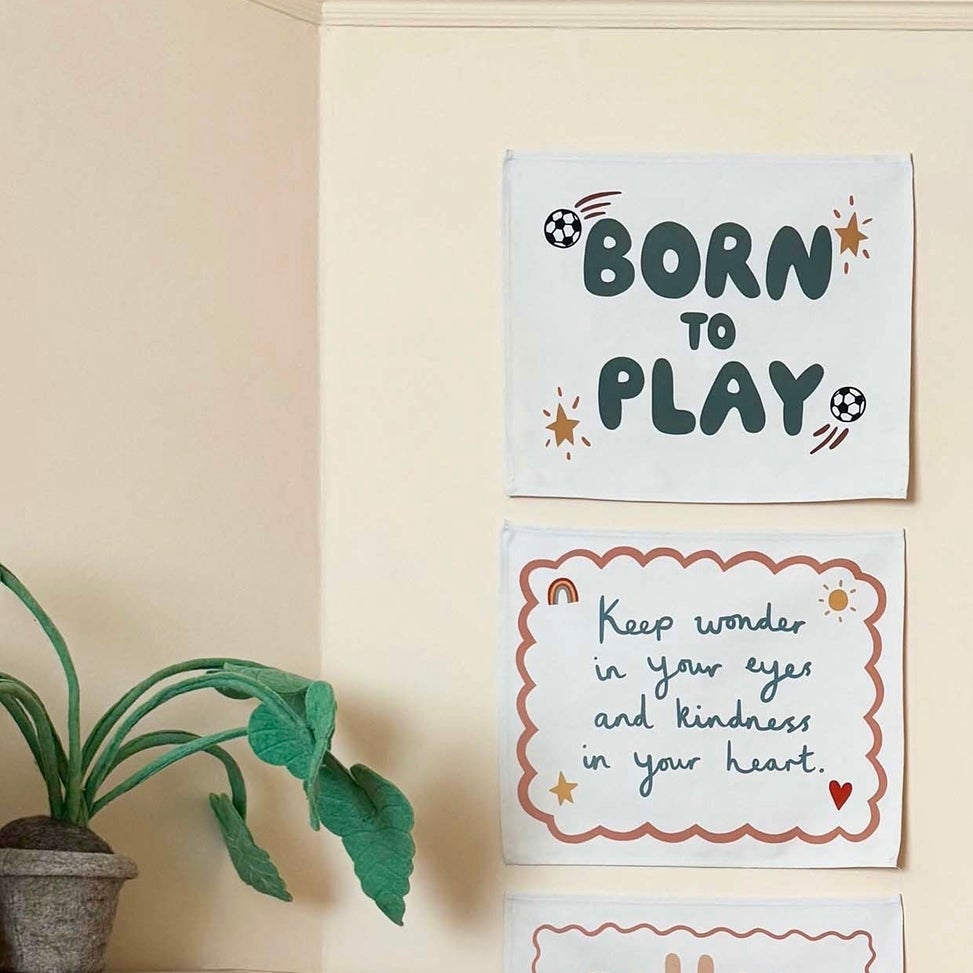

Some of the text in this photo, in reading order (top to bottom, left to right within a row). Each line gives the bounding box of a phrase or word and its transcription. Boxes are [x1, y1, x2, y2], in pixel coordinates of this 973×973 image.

[583, 216, 832, 301] BORN
[680, 312, 736, 350] TO
[598, 357, 825, 436] PLAY
[599, 595, 806, 644] Keep wonder
[594, 656, 812, 703] in your eyes
[594, 692, 811, 733] and kindness
[583, 740, 824, 797] in your heart.
